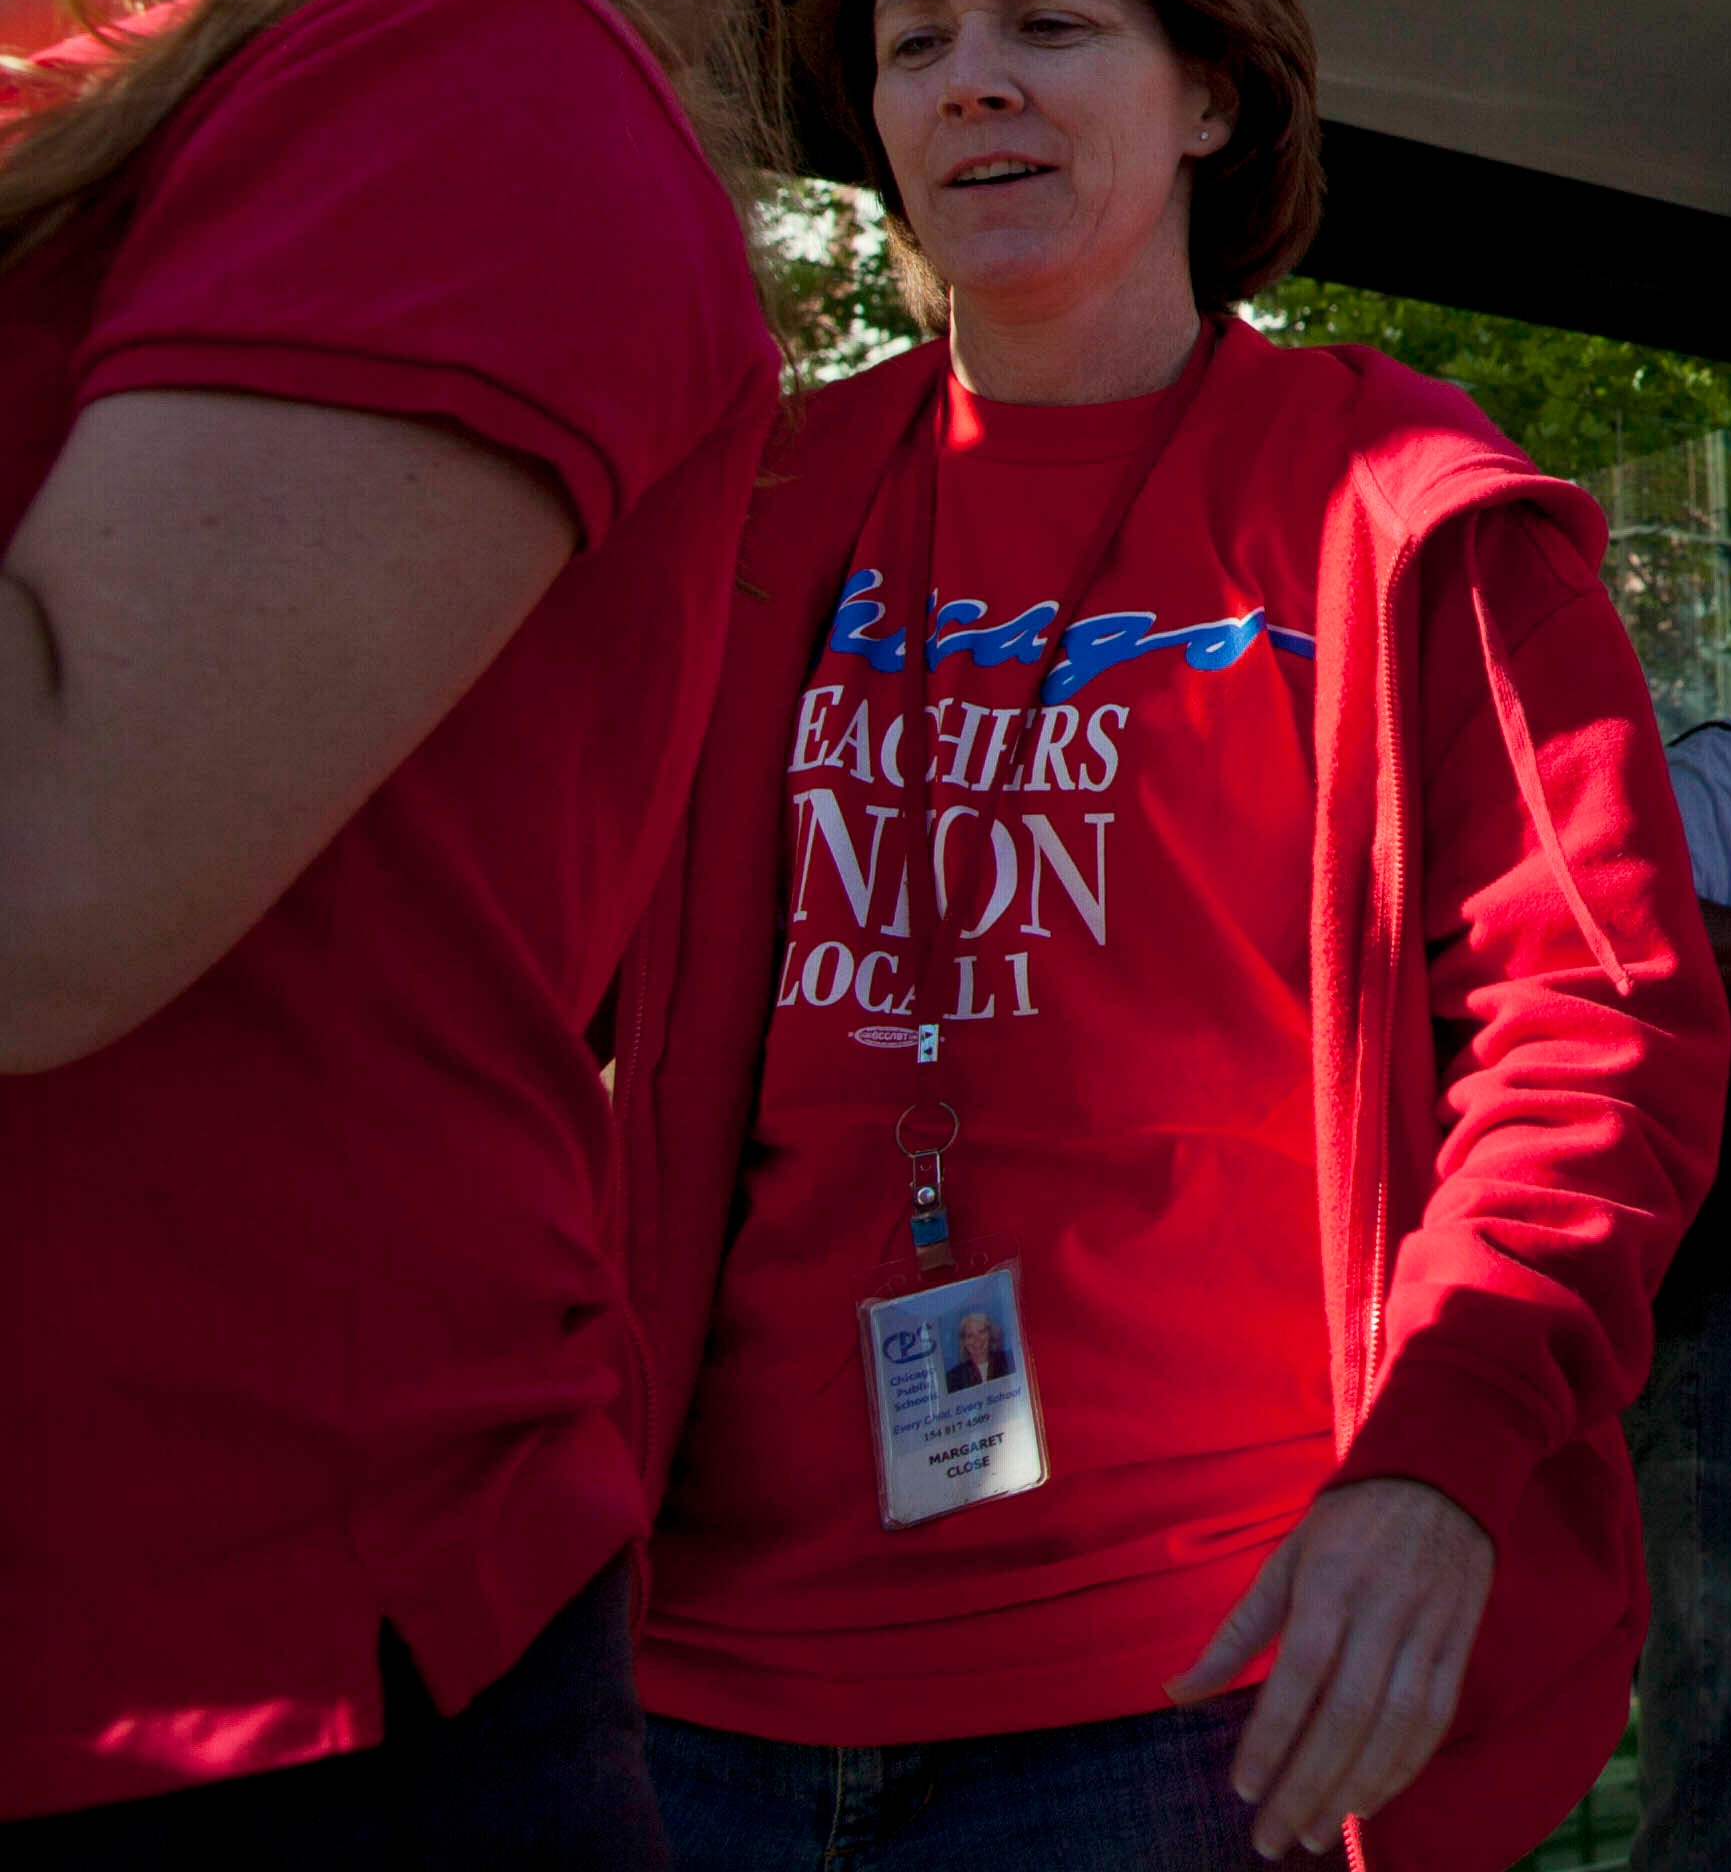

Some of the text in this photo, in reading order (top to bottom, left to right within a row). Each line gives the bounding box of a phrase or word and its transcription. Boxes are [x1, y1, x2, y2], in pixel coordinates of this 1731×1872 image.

[787, 684, 1130, 792] EACHERS
[793, 787, 1116, 948] NON
[928, 1432, 1005, 1466] MARGARET
[946, 1455, 991, 1479] CLOSE
